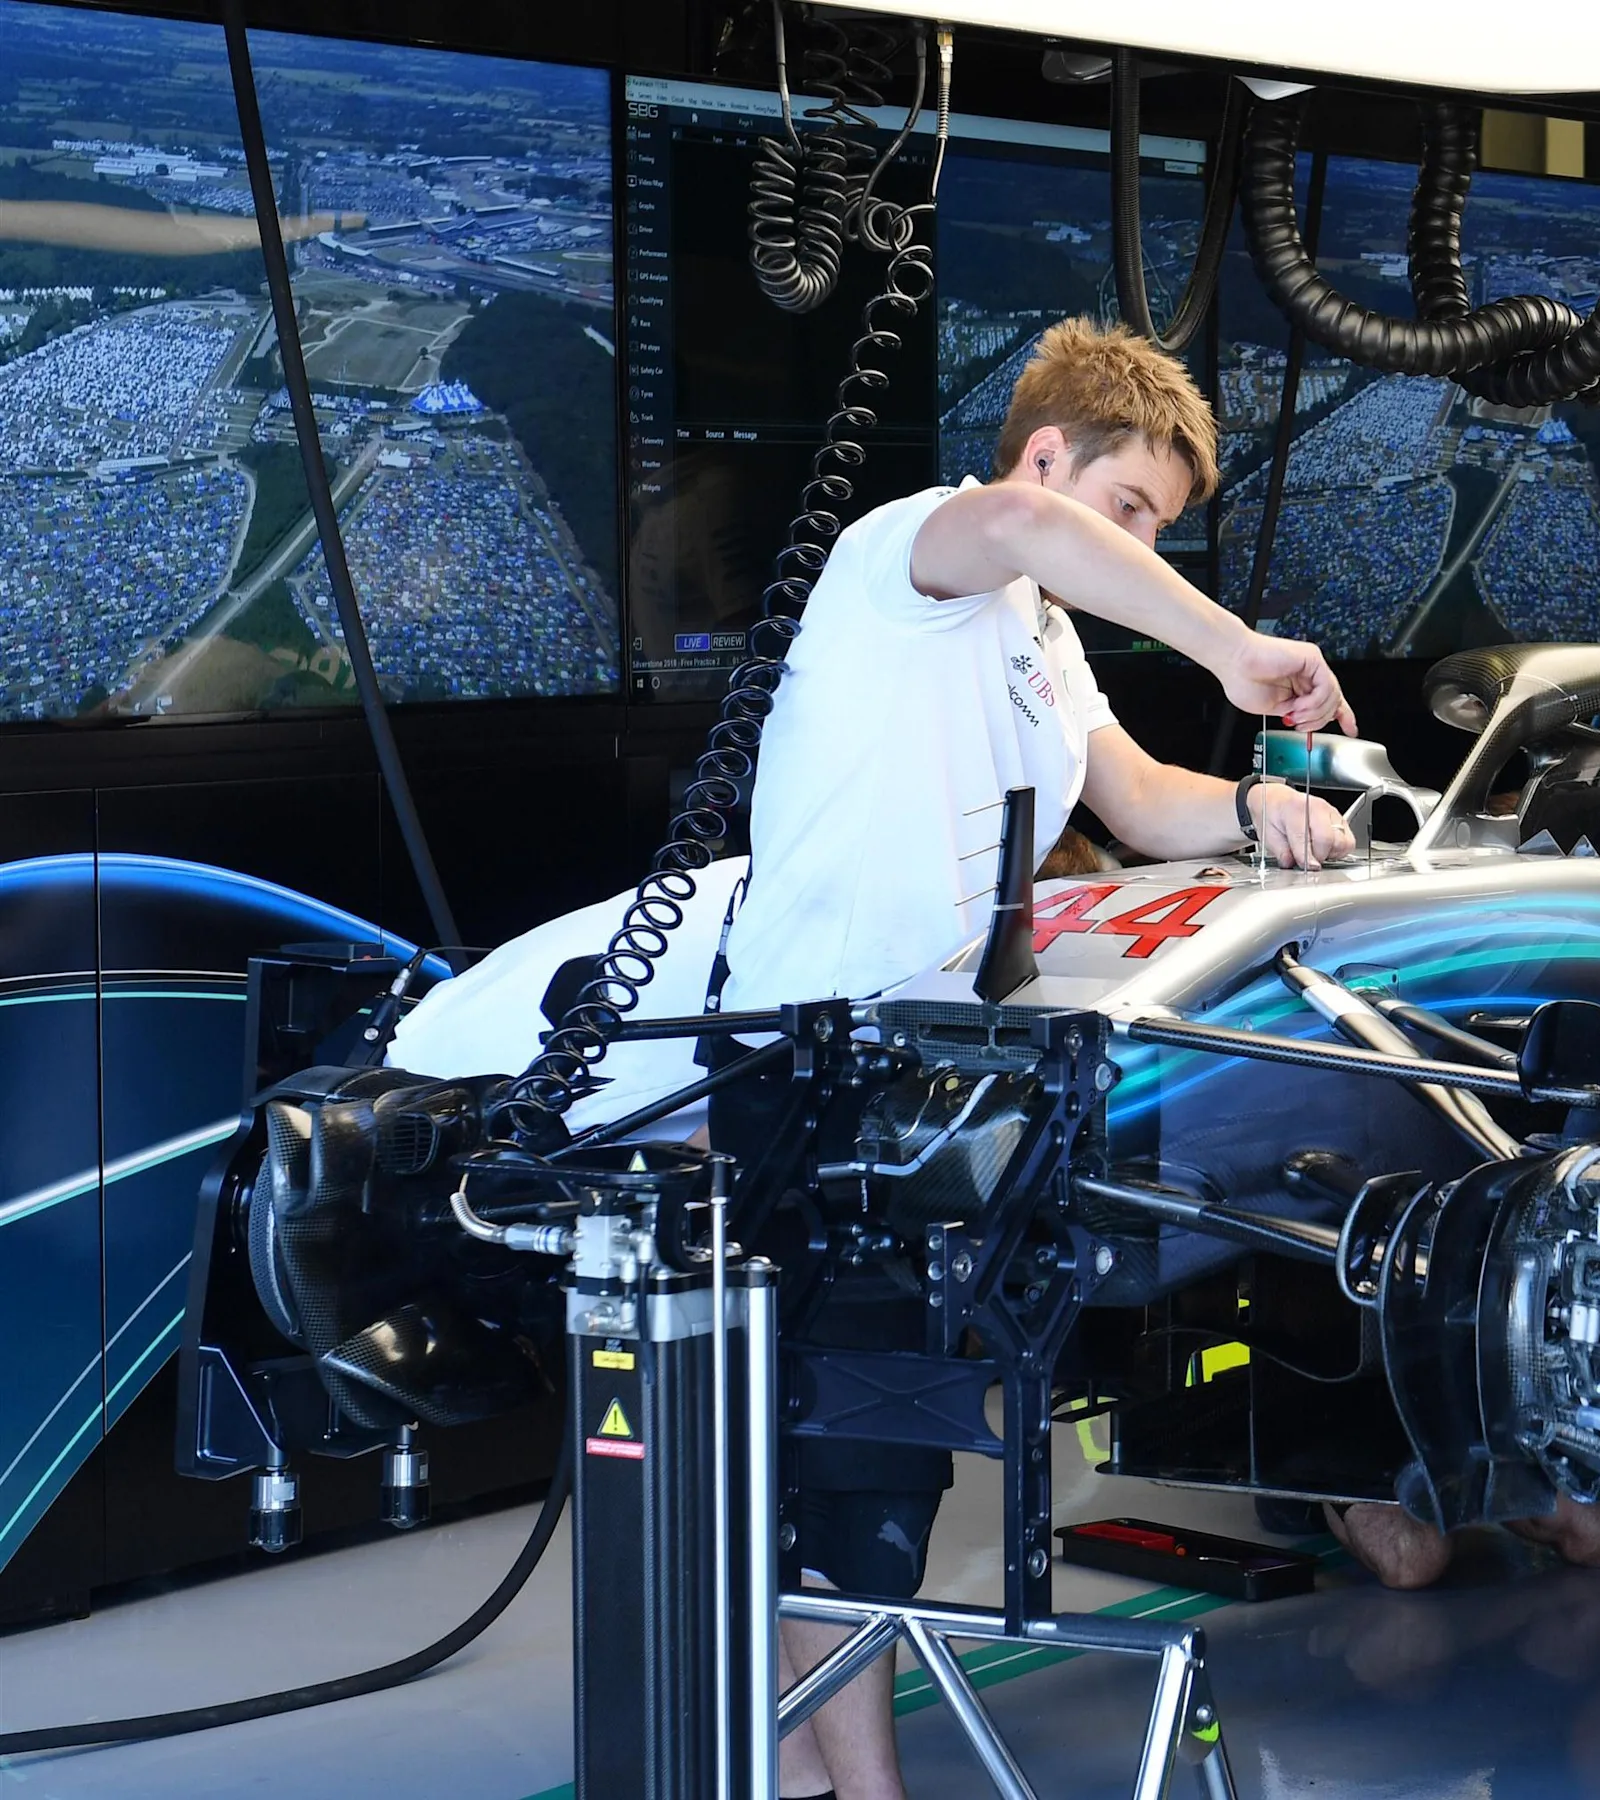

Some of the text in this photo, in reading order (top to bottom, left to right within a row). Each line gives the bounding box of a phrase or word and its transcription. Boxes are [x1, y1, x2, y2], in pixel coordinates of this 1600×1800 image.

[628, 102, 659, 118] SBG
[640, 249, 668, 258] Performance
[640, 272, 668, 282] GPS Analysis
[640, 296, 664, 306] Qualifying
[641, 389, 653, 398] Tyres
[641, 412, 654, 421] Track
[676, 428, 758, 440] Time Source Message
[641, 436, 664, 446] Telemetry
[641, 460, 661, 468] Weather
[683, 636, 743, 649] LIVE REVIEW
[632, 659, 663, 668] Silverstone
[680, 658, 693, 667] Free
[693, 657, 715, 667] Practice
[1027, 671, 1055, 707] UBS
[1033, 882, 1233, 959] 44
